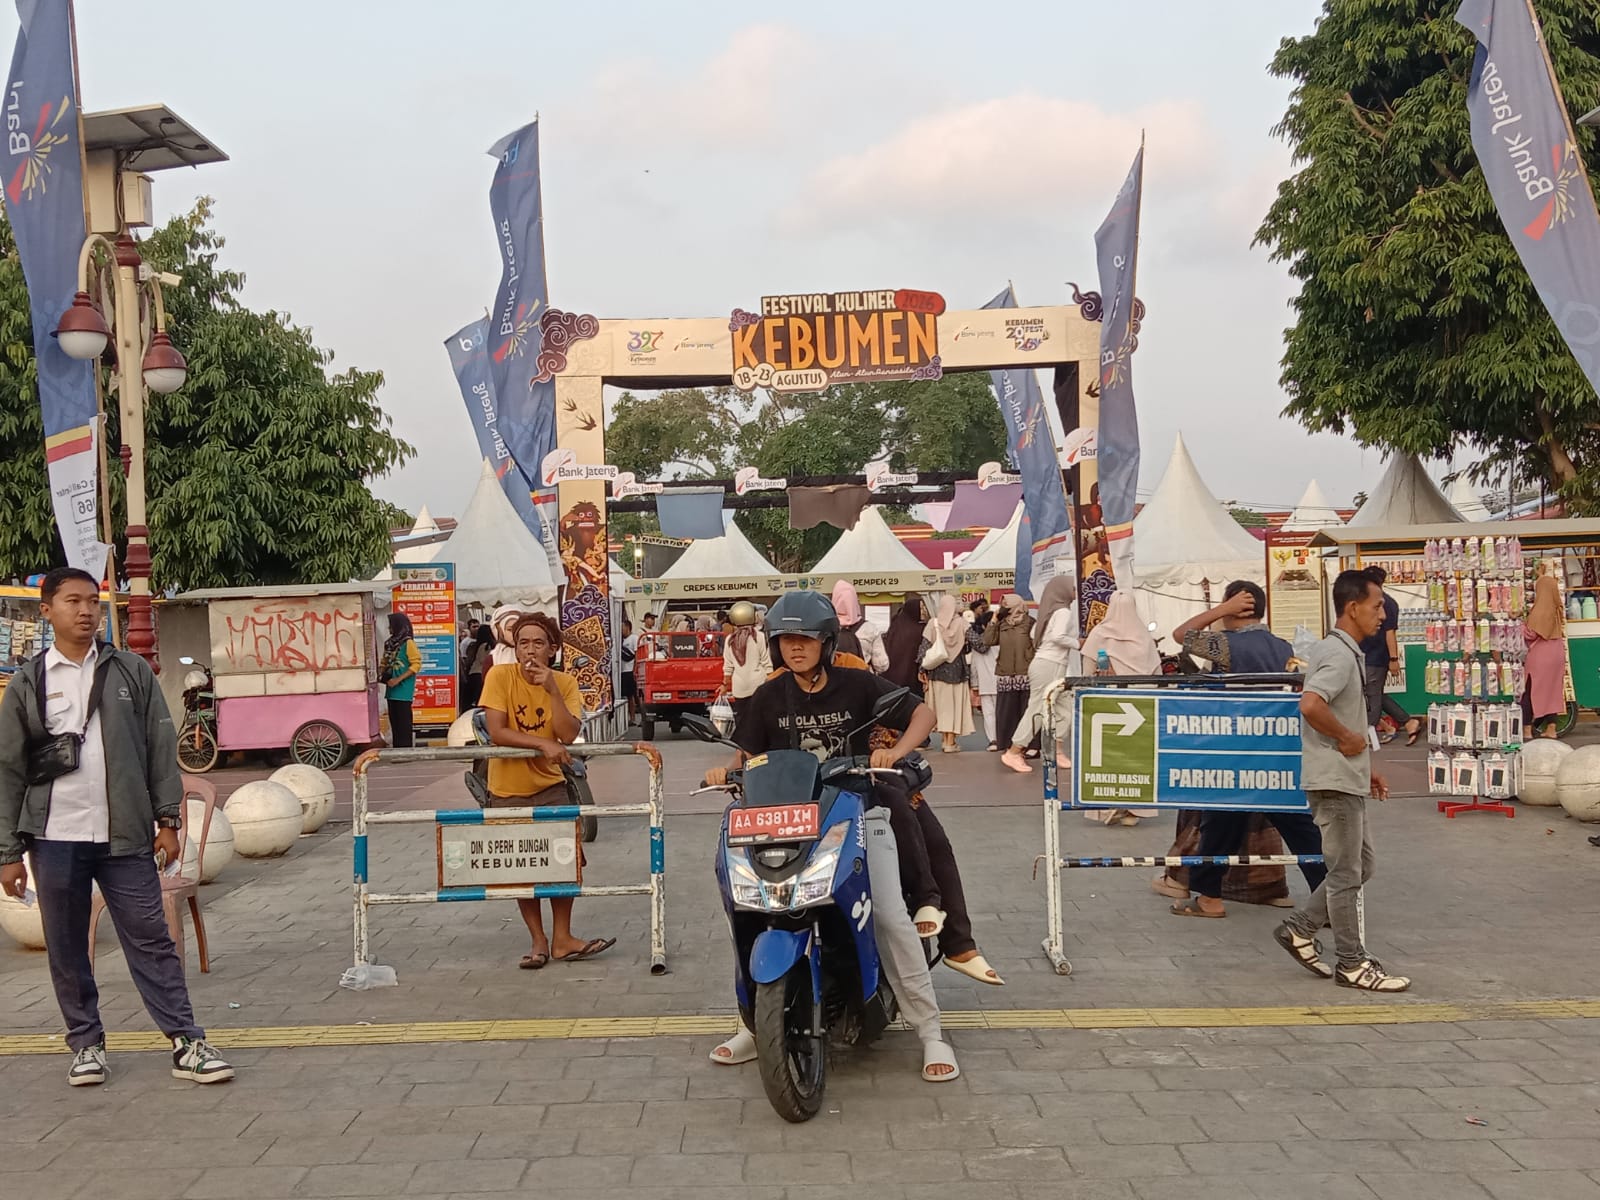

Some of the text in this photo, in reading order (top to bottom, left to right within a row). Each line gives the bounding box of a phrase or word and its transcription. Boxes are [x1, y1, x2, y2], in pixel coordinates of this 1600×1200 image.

[762, 294, 832, 316] FESTIVAL
[835, 290, 896, 312] KULINER
[1005, 318, 1044, 326] KEBUMEN
[627, 330, 664, 353] 397
[733, 310, 938, 371] KEBUMEN
[776, 373, 823, 387] AGUSTUS
[558, 466, 617, 478] Bank Jateng
[745, 480, 785, 488] Bank Jateng
[876, 474, 917, 484] Bank Jateng
[987, 475, 1005, 483] Bank
[622, 485, 640, 493] Bank
[683, 583, 715, 592] CREPES
[717, 582, 758, 590] KEBUMEN
[853, 577, 899, 586] PEMPEK 29
[961, 592, 985, 602] SOTO
[817, 710, 852, 725] TESLA
[1166, 714, 1300, 737] PARKIR MOTOR
[1084, 772, 1151, 785] PARKIR MASUK
[1169, 768, 1296, 790] PARKIR MOBIL
[1093, 786, 1141, 797] ALUN-ALUN
[735, 814, 751, 828] AA
[756, 810, 788, 826] 6381
[518, 838, 549, 853] BUNGAN
[470, 857, 549, 869] KEBUMEN
